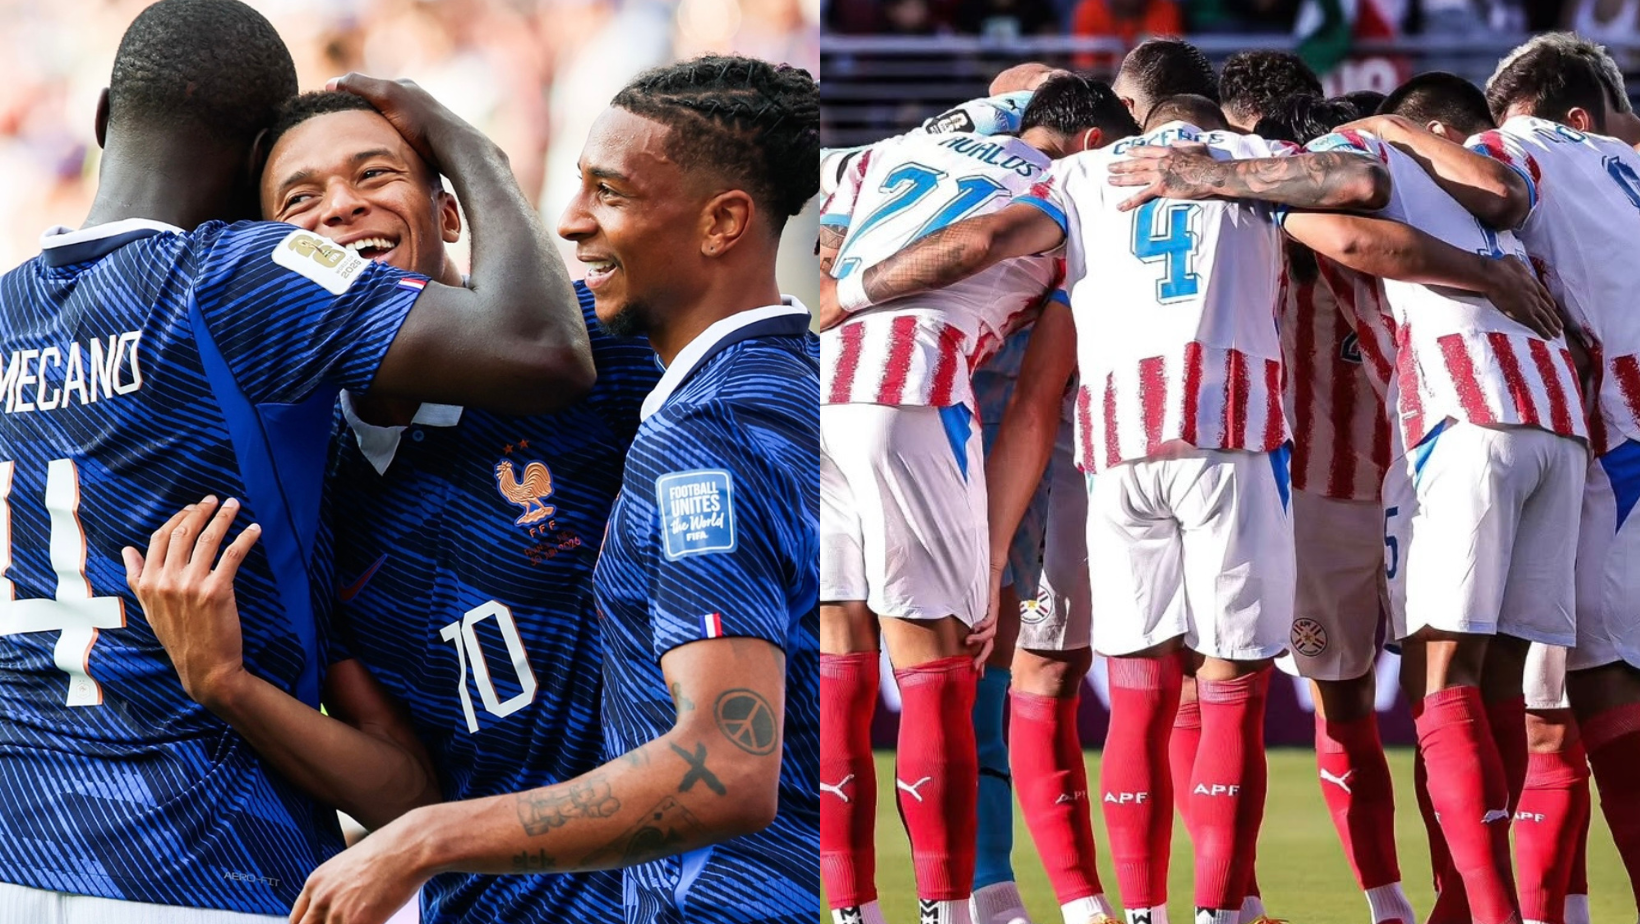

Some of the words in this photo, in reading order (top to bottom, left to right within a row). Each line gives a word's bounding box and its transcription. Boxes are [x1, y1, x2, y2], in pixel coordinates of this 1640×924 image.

[1130, 196, 1204, 306] 4
[341, 259, 362, 279] 2026
[669, 481, 719, 500] FOOTBALL
[670, 494, 721, 518] UNITES
[670, 517, 689, 535] the
[689, 511, 725, 533] World
[686, 530, 709, 542] FIFA
[440, 600, 539, 734] 10
[1104, 791, 1148, 804] APF
[1193, 783, 1240, 797] APF
[223, 871, 281, 887] AERO-FIT
